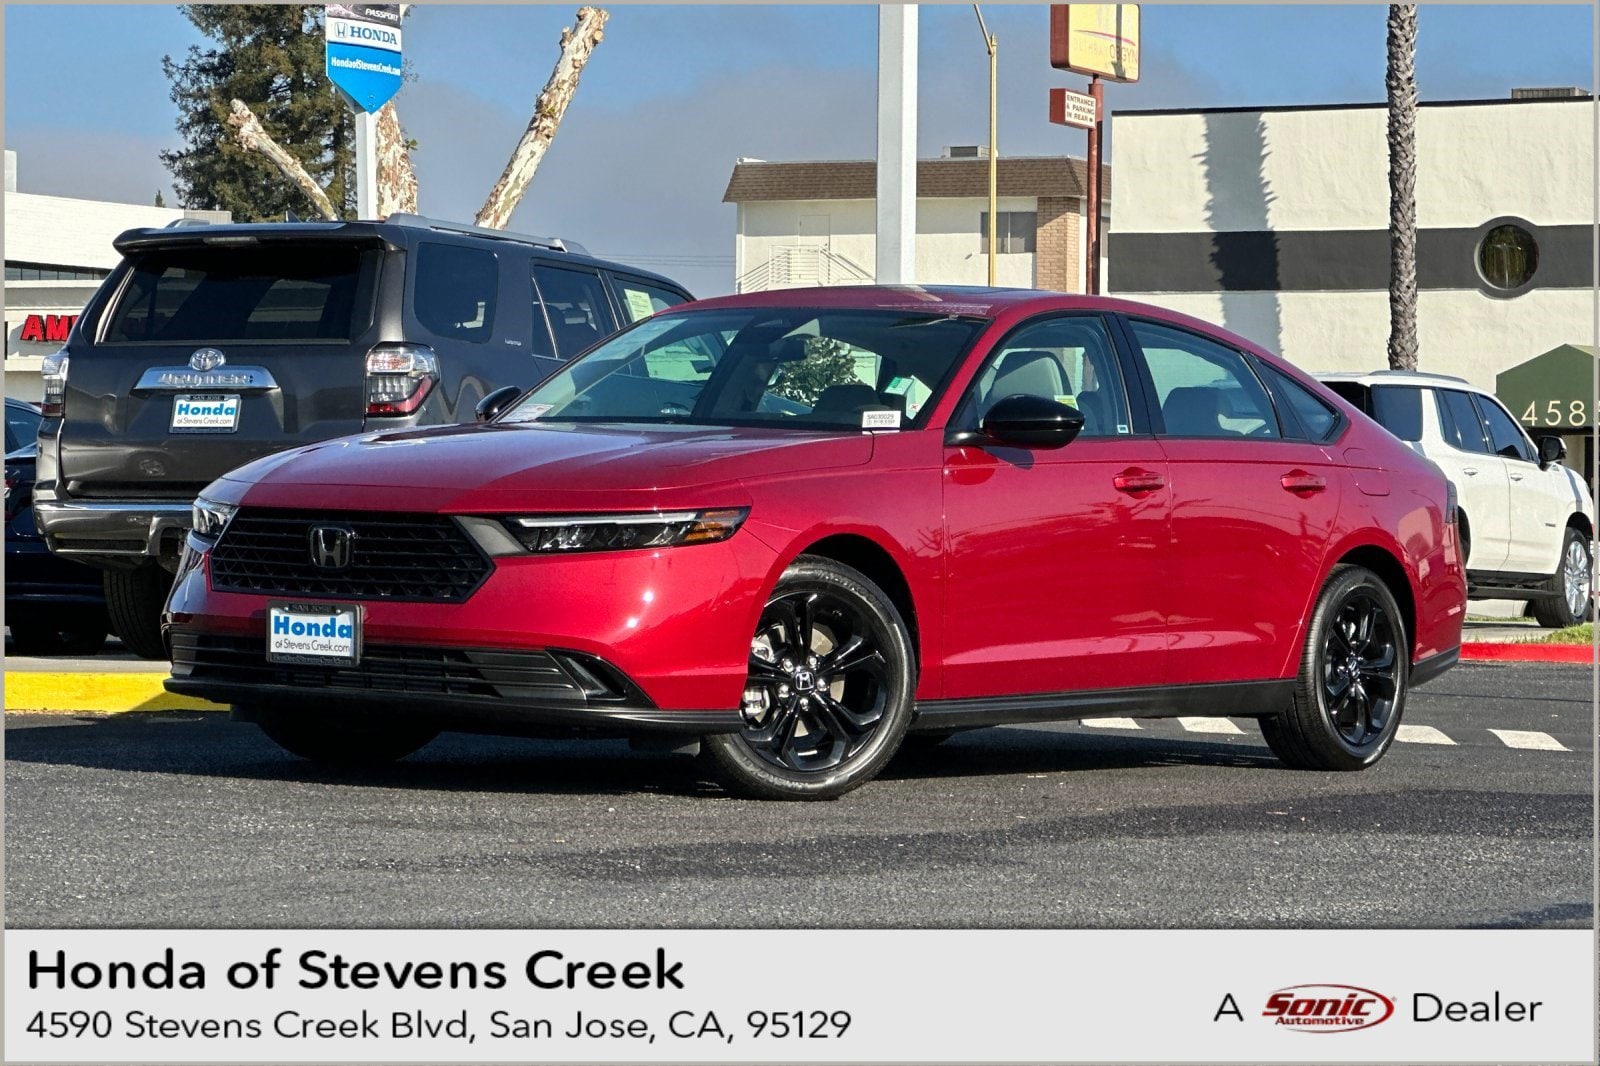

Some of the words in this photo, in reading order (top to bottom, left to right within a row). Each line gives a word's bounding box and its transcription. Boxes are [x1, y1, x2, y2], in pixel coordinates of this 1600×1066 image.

[365, 8, 398, 21] PASSPORT
[350, 26, 397, 45] HONDA
[1067, 95, 1094, 107] ENTRANCE
[1073, 104, 1094, 115] PARKING
[1074, 113, 1088, 121] REAR
[21, 314, 80, 342] AM
[177, 403, 235, 415] Honda
[203, 416, 231, 424] Creek.com
[274, 616, 352, 638] Honda
[275, 640, 282, 648] of
[283, 639, 310, 650] Stevens
[311, 640, 349, 652] Creek.com
